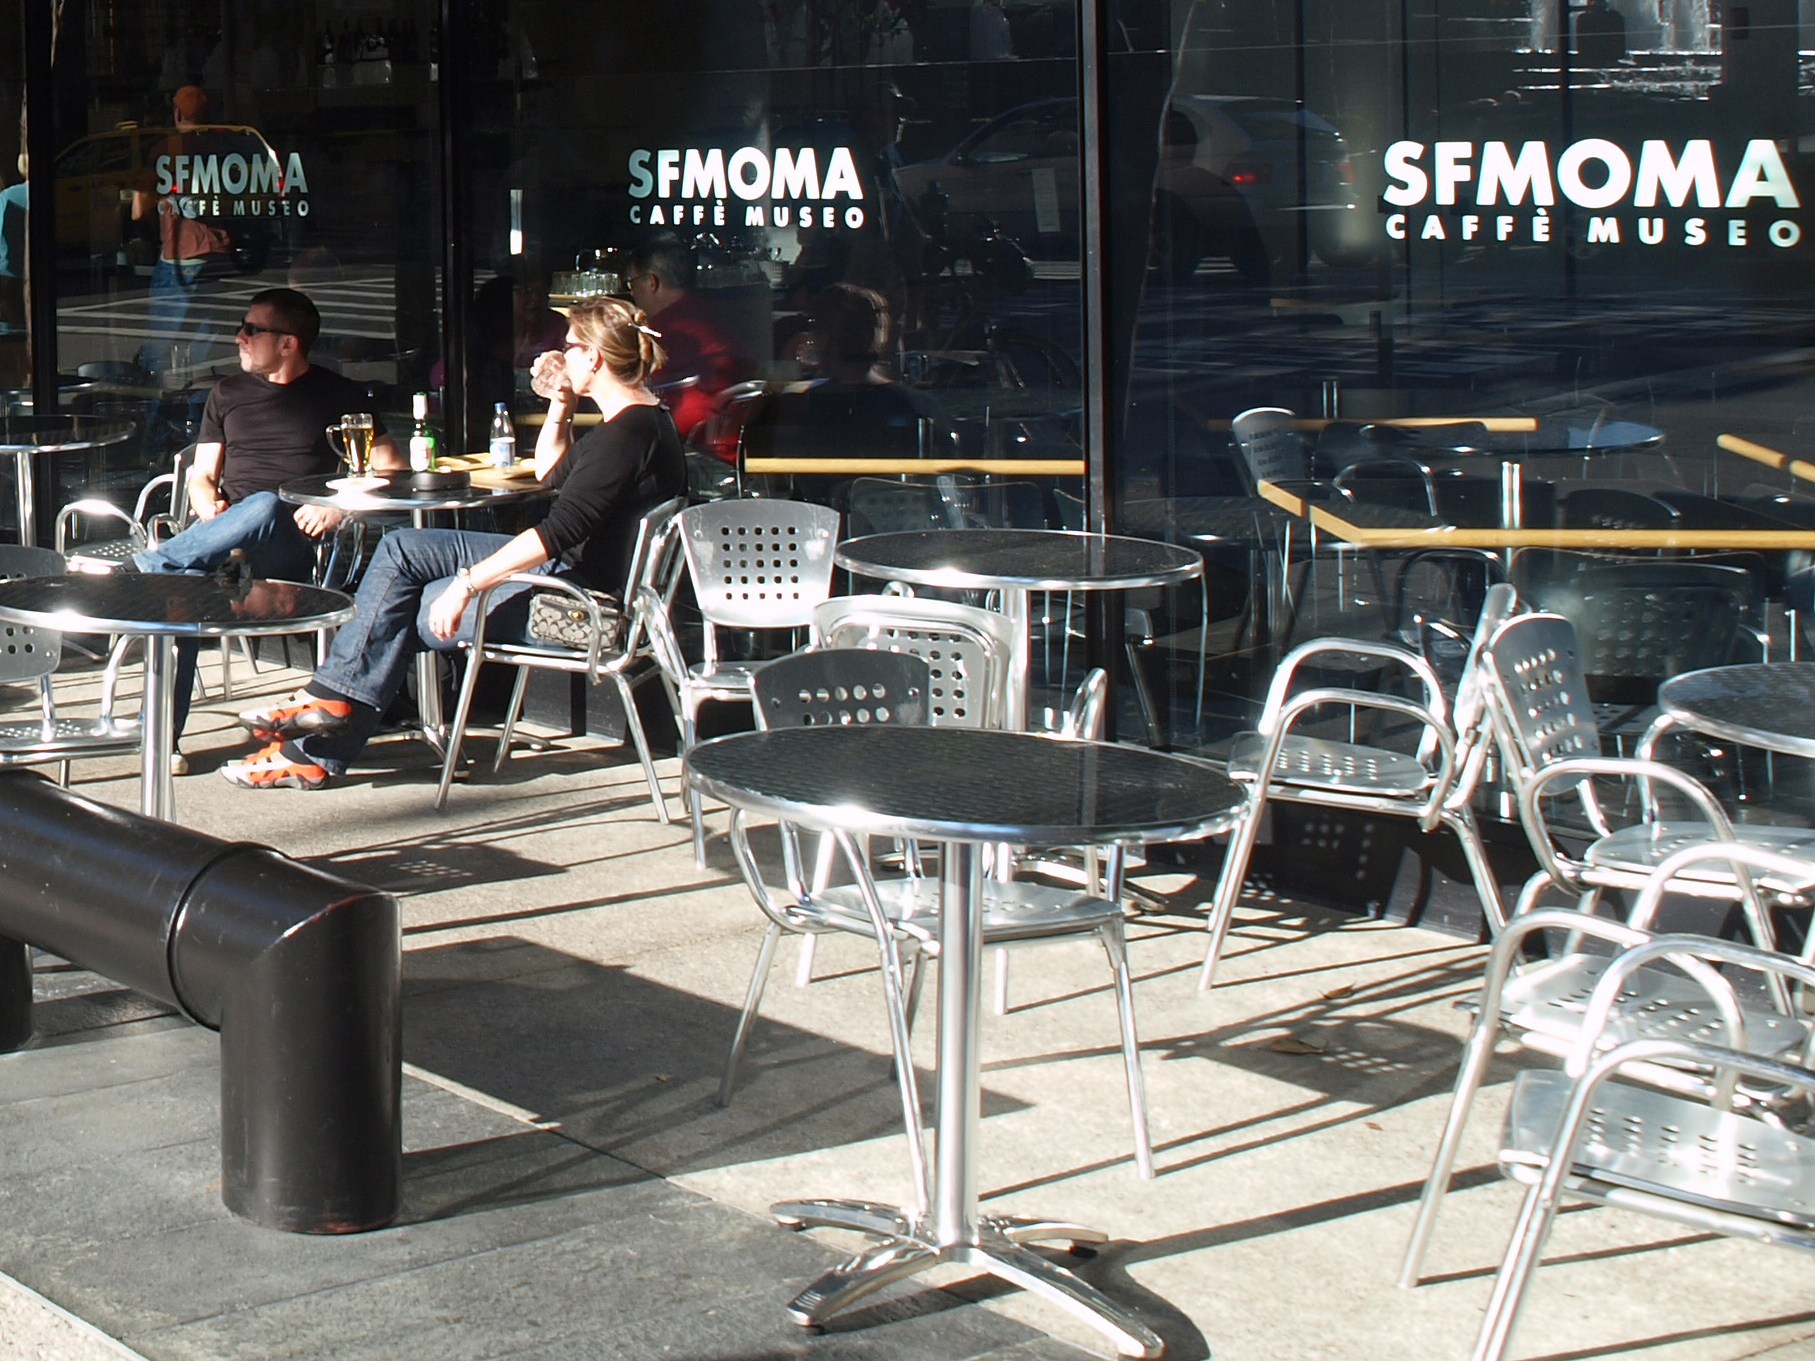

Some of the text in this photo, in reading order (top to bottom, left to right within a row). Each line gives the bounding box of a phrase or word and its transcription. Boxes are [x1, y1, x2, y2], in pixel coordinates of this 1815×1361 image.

[156, 152, 308, 195] SFMOMA
[628, 146, 864, 200] SFMOMA
[1383, 138, 1801, 209] SFMOMA
[233, 200, 309, 217] MUSEO
[629, 199, 864, 229] CAFFÈ MUSEO
[1385, 208, 1801, 248] CAFFÈ MUSEO
